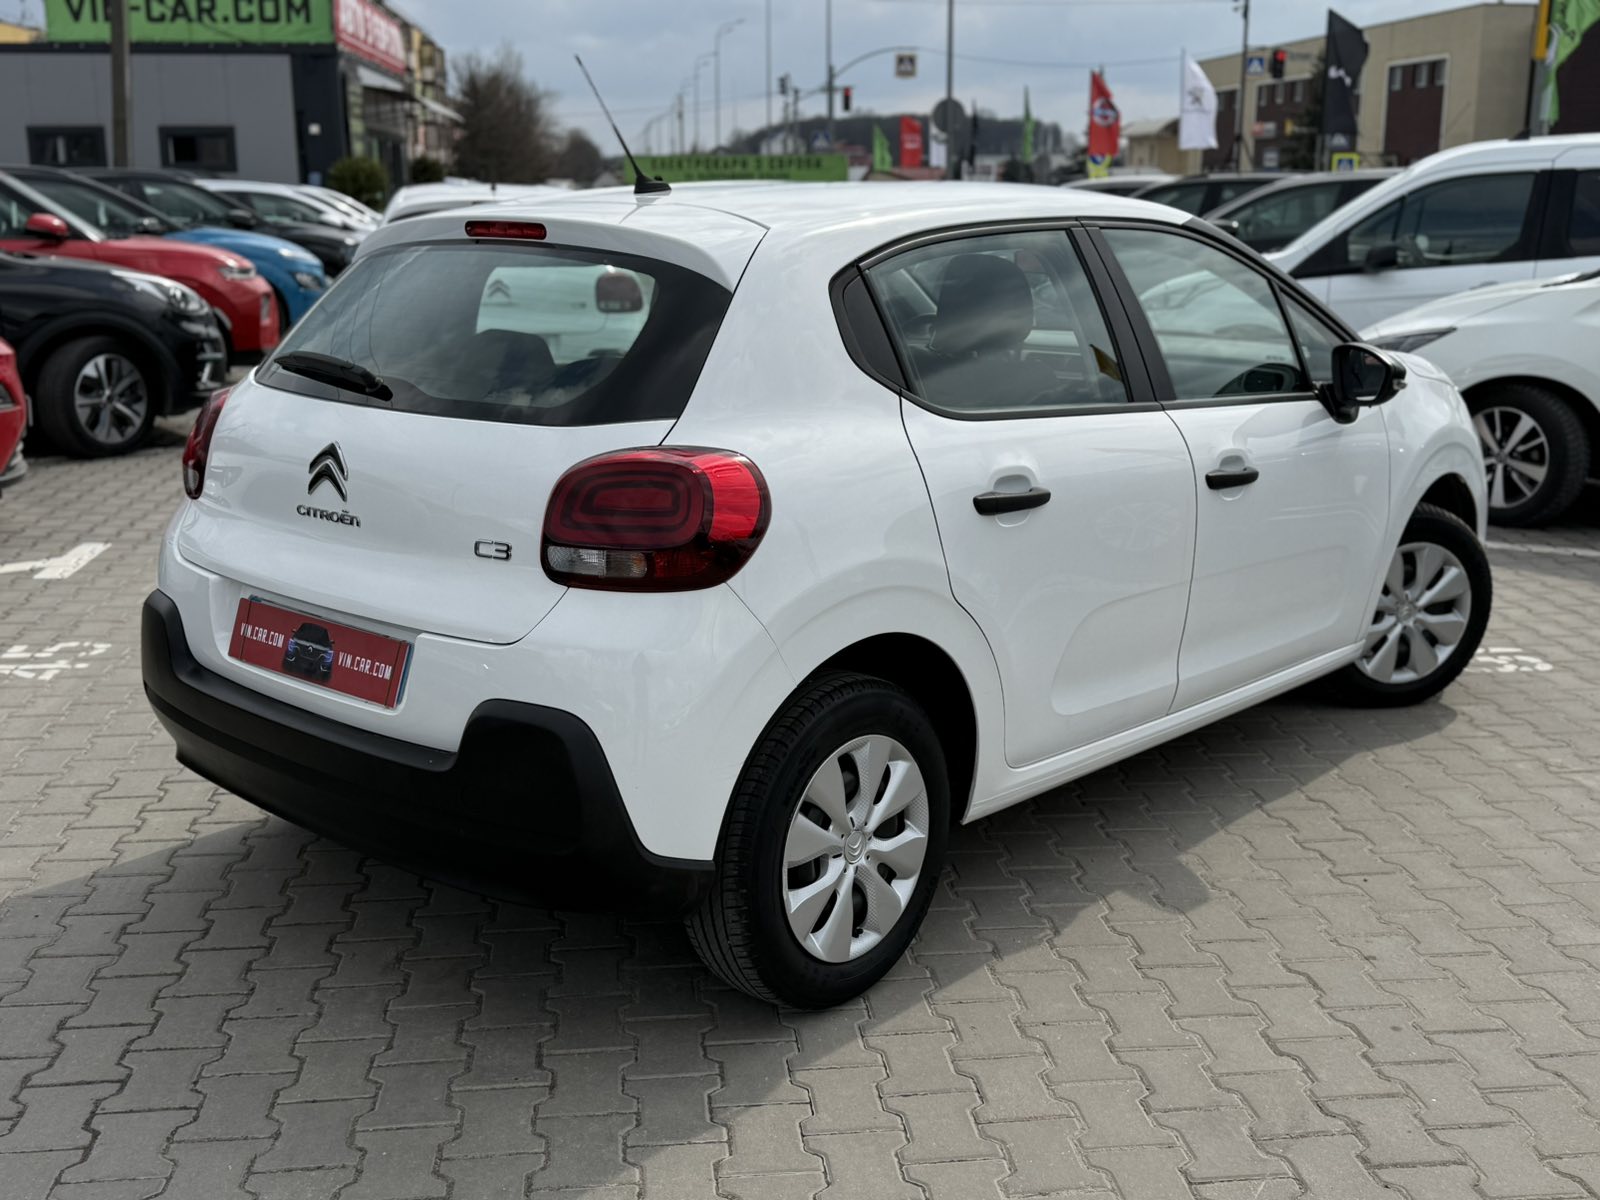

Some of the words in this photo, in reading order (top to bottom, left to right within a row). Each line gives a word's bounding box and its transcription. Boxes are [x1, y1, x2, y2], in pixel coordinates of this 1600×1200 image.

[474, 540, 512, 561] C3
[240, 622, 285, 649] VIN.CAR.COM
[338, 651, 393, 680] VIN.CAR.COM
